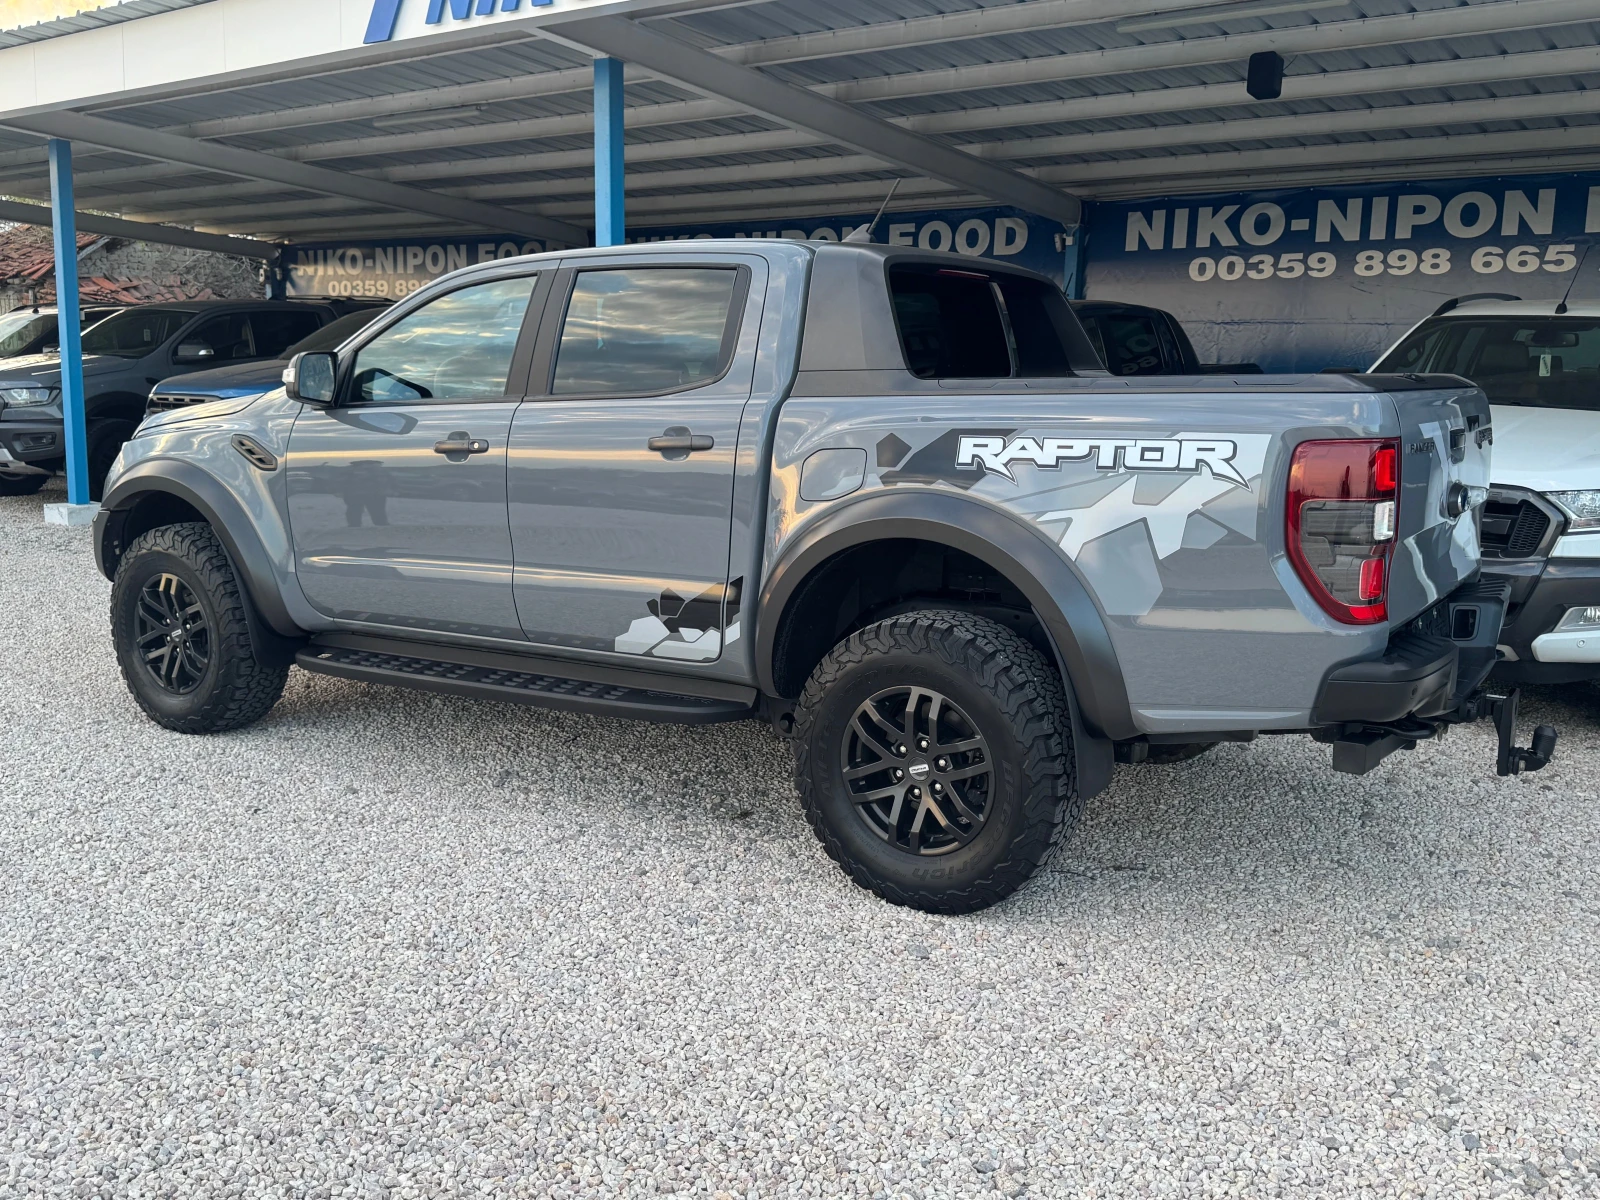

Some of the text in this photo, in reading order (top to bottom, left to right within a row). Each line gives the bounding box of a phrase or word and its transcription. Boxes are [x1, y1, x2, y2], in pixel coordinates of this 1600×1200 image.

[887, 217, 1029, 257] FOOD
[1125, 188, 1557, 252] NIKO-NIPON
[297, 244, 468, 277] NIKO-NIPON
[1188, 243, 1577, 282] 00359 898 665
[328, 279, 389, 297] 00359
[955, 435, 1253, 493] RAPTOR
